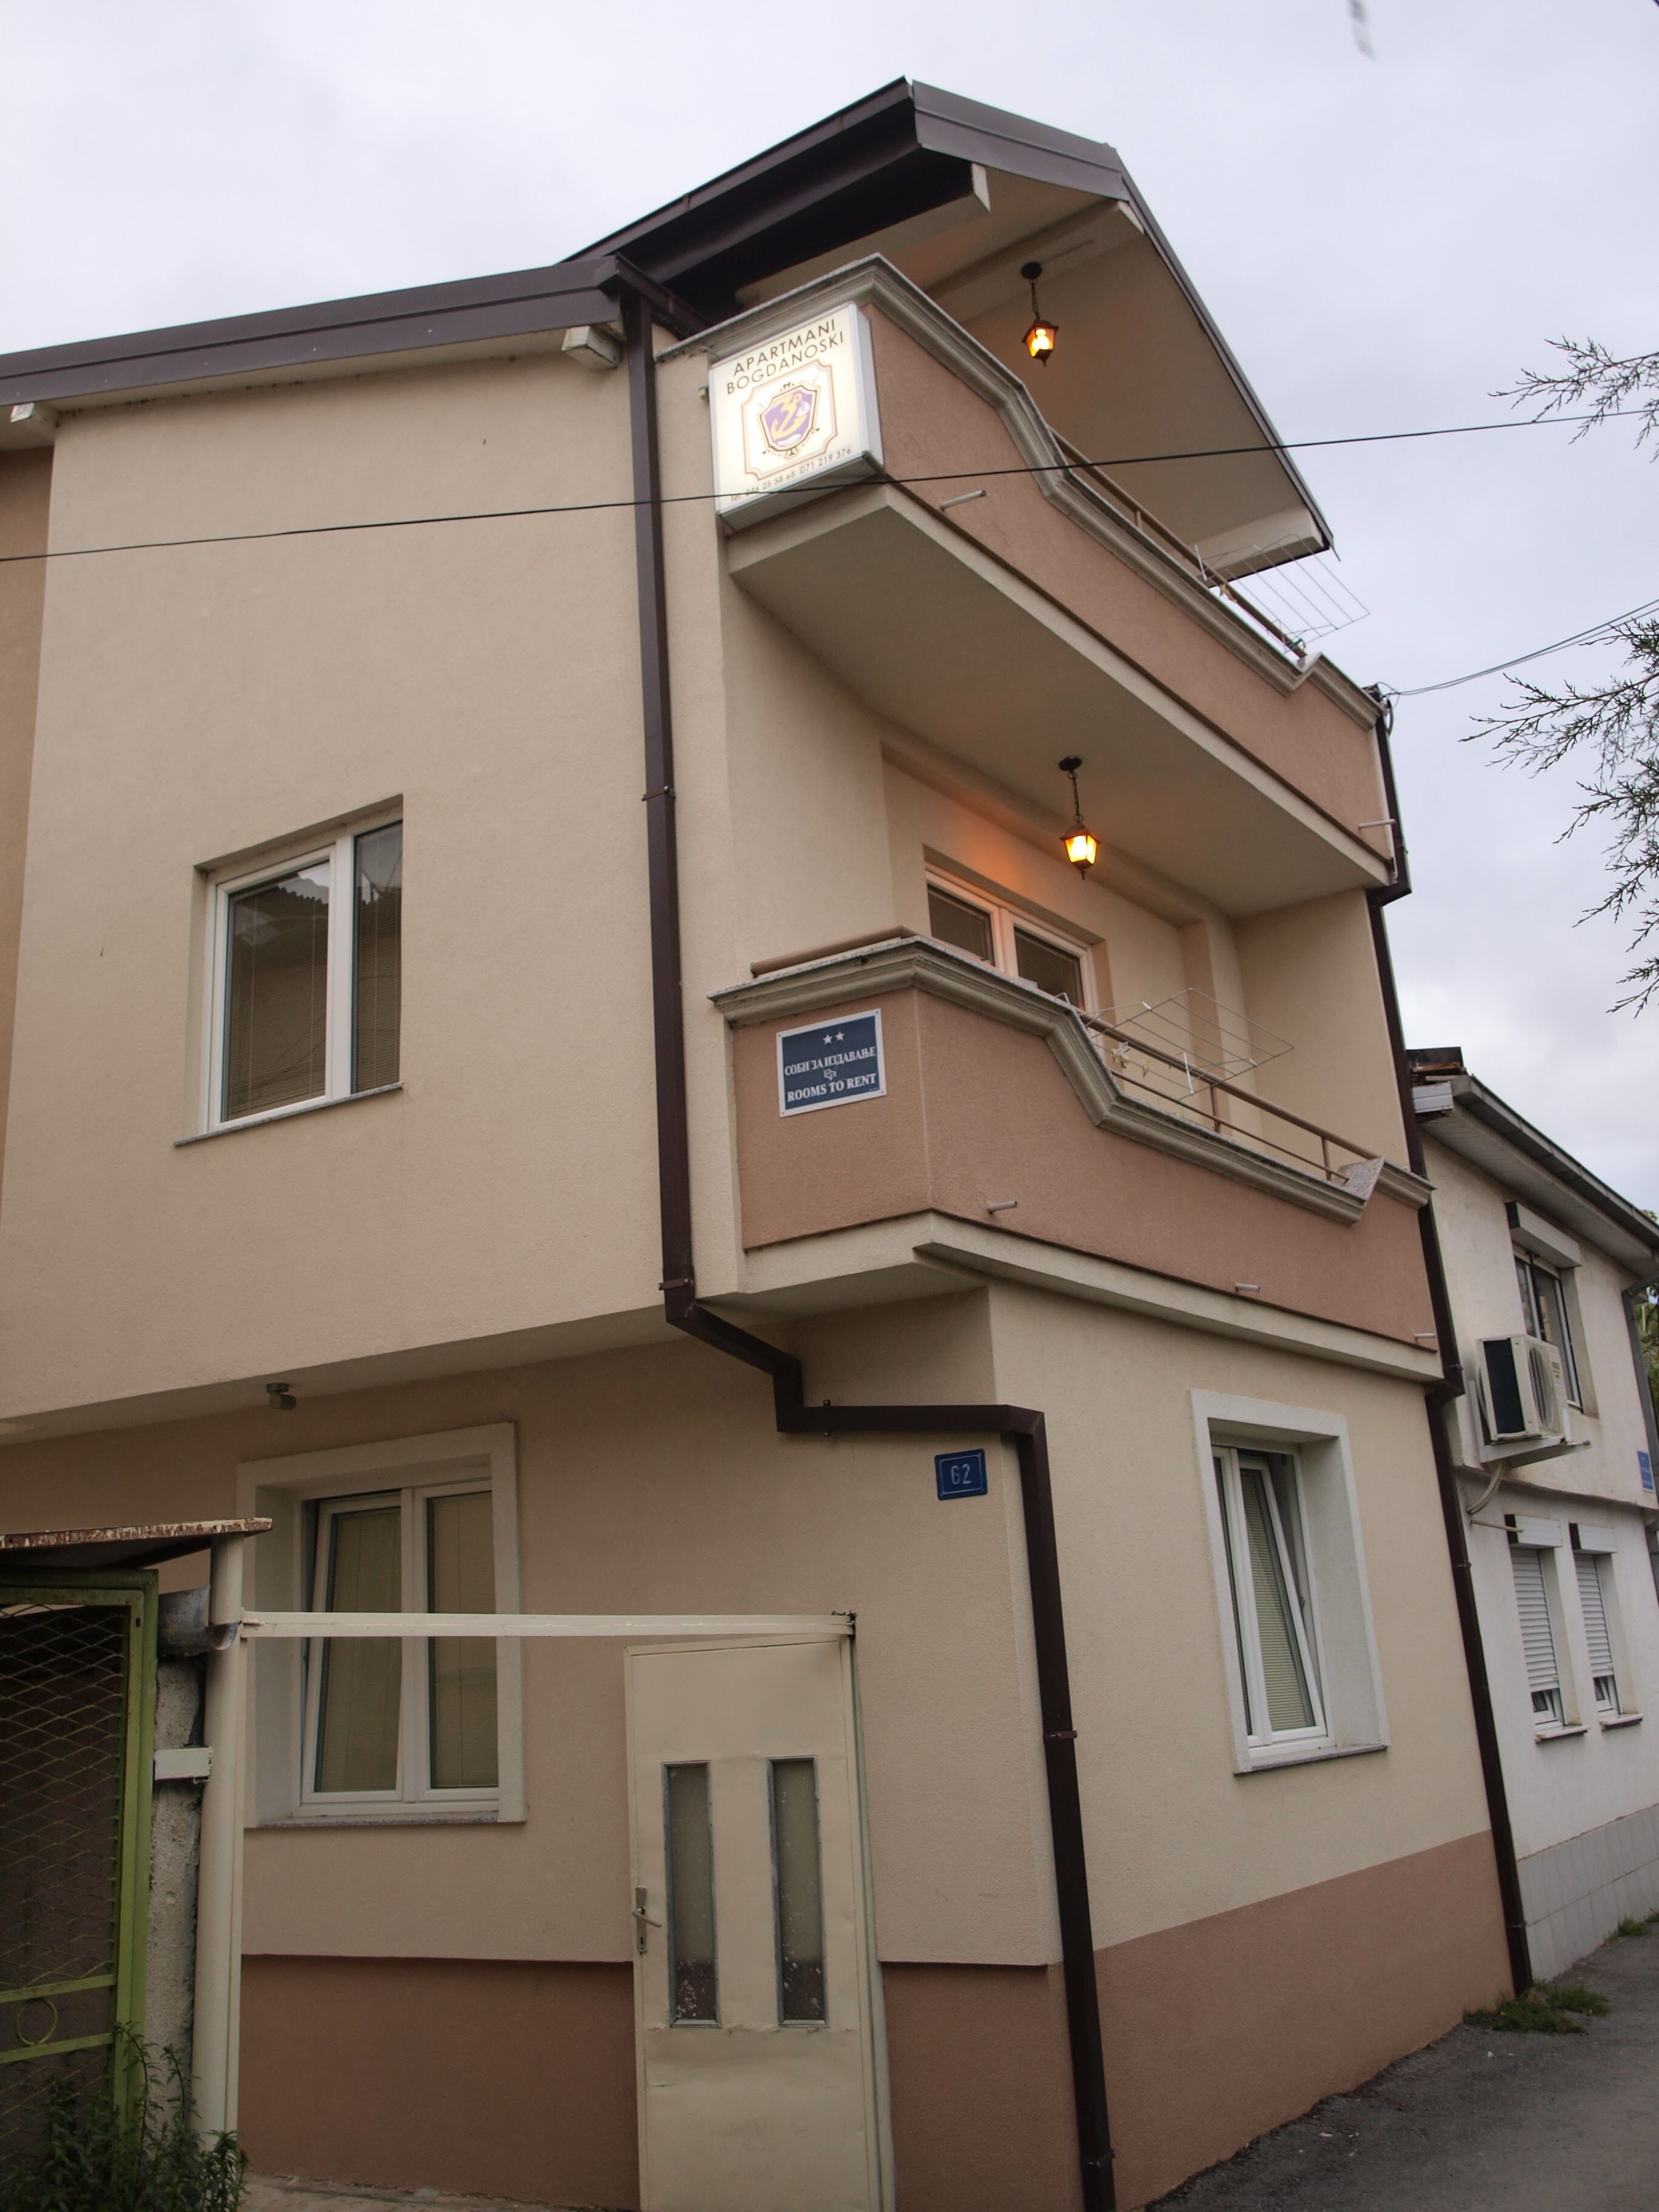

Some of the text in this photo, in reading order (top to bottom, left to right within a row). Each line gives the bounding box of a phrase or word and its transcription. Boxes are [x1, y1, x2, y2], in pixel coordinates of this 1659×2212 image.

[726, 331, 844, 395] BOGDANOSKI
[733, 319, 836, 377] APARTMANI
[800, 461, 814, 474] 071
[819, 454, 833, 466] 219
[836, 446, 851, 459] 376
[785, 1046, 877, 1076] СОБИ ЗА ИЗДАВАЊЕ
[786, 1073, 877, 1102] ROOMS TO RENT
